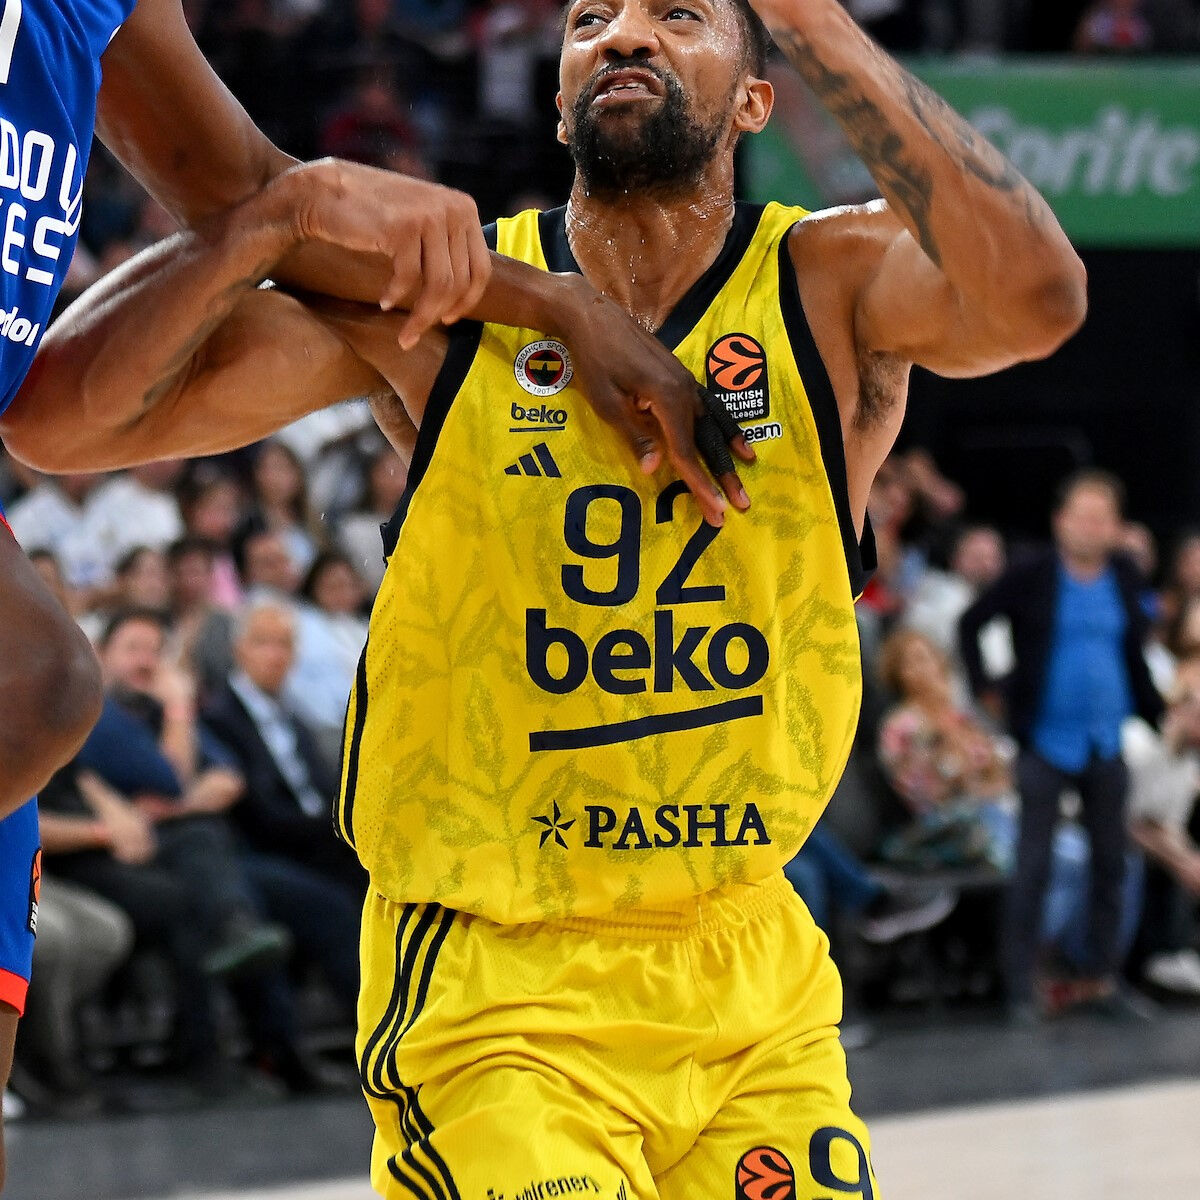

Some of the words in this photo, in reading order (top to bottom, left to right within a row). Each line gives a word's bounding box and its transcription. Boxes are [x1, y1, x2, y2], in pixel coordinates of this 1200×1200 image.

[510, 402, 568, 425] beko
[724, 398, 764, 412] RLINES
[730, 408, 765, 420] League
[561, 479, 726, 607] 92
[525, 608, 769, 695] beko
[583, 802, 772, 850] PASHA
